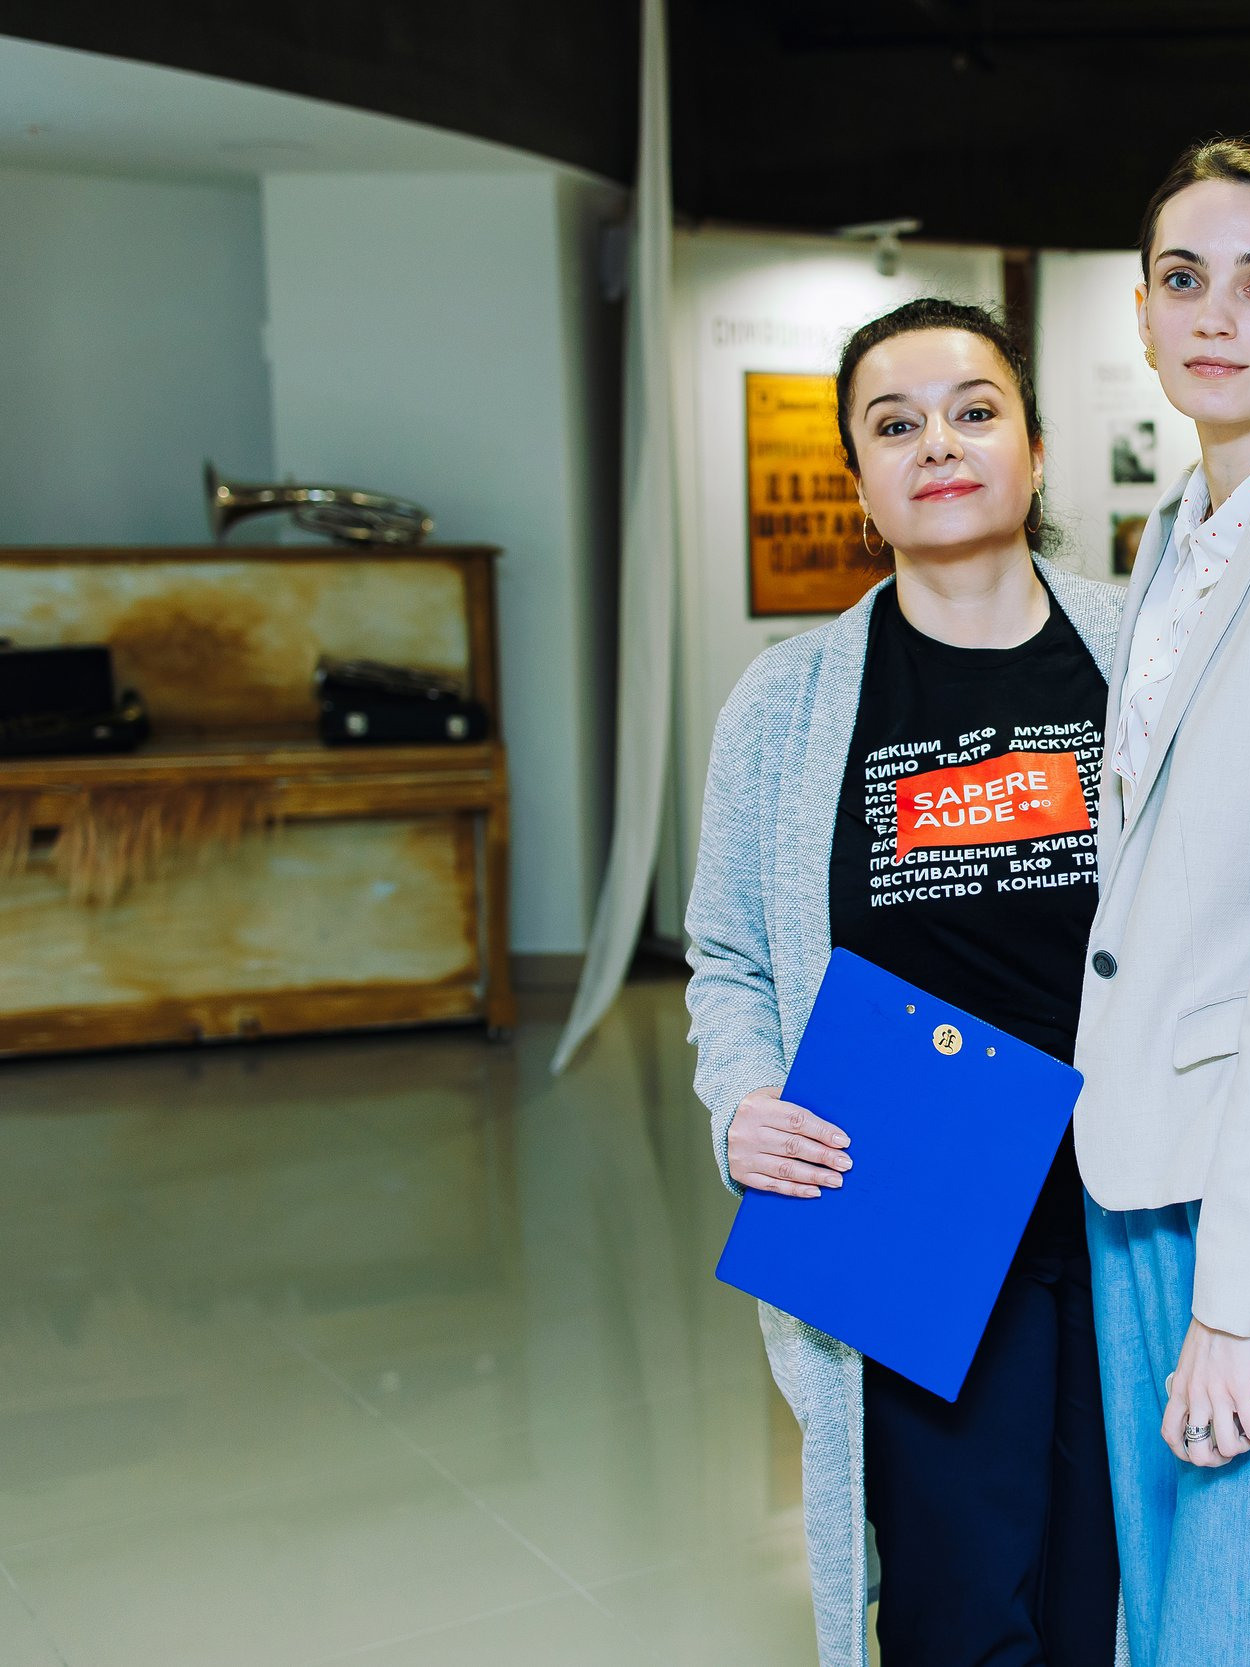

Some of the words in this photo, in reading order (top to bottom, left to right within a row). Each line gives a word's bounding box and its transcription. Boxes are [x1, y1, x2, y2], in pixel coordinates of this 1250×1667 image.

[865, 739, 941, 764] ЛЕКЦИИ
[959, 727, 997, 747] БКФ
[1014, 720, 1094, 737] МУЗЫКА
[865, 759, 918, 780] КИНО
[936, 744, 991, 766] ТЕАТР
[913, 771, 1048, 811] SAPERE
[913, 801, 1016, 829] AUDE
[870, 845, 1017, 872] ПРОСВЕЩЕНИЕ
[870, 864, 988, 889] ФЕСТИВАЛИ
[1010, 857, 1052, 873] БКФ
[871, 882, 983, 908] ИСКУССТВО
